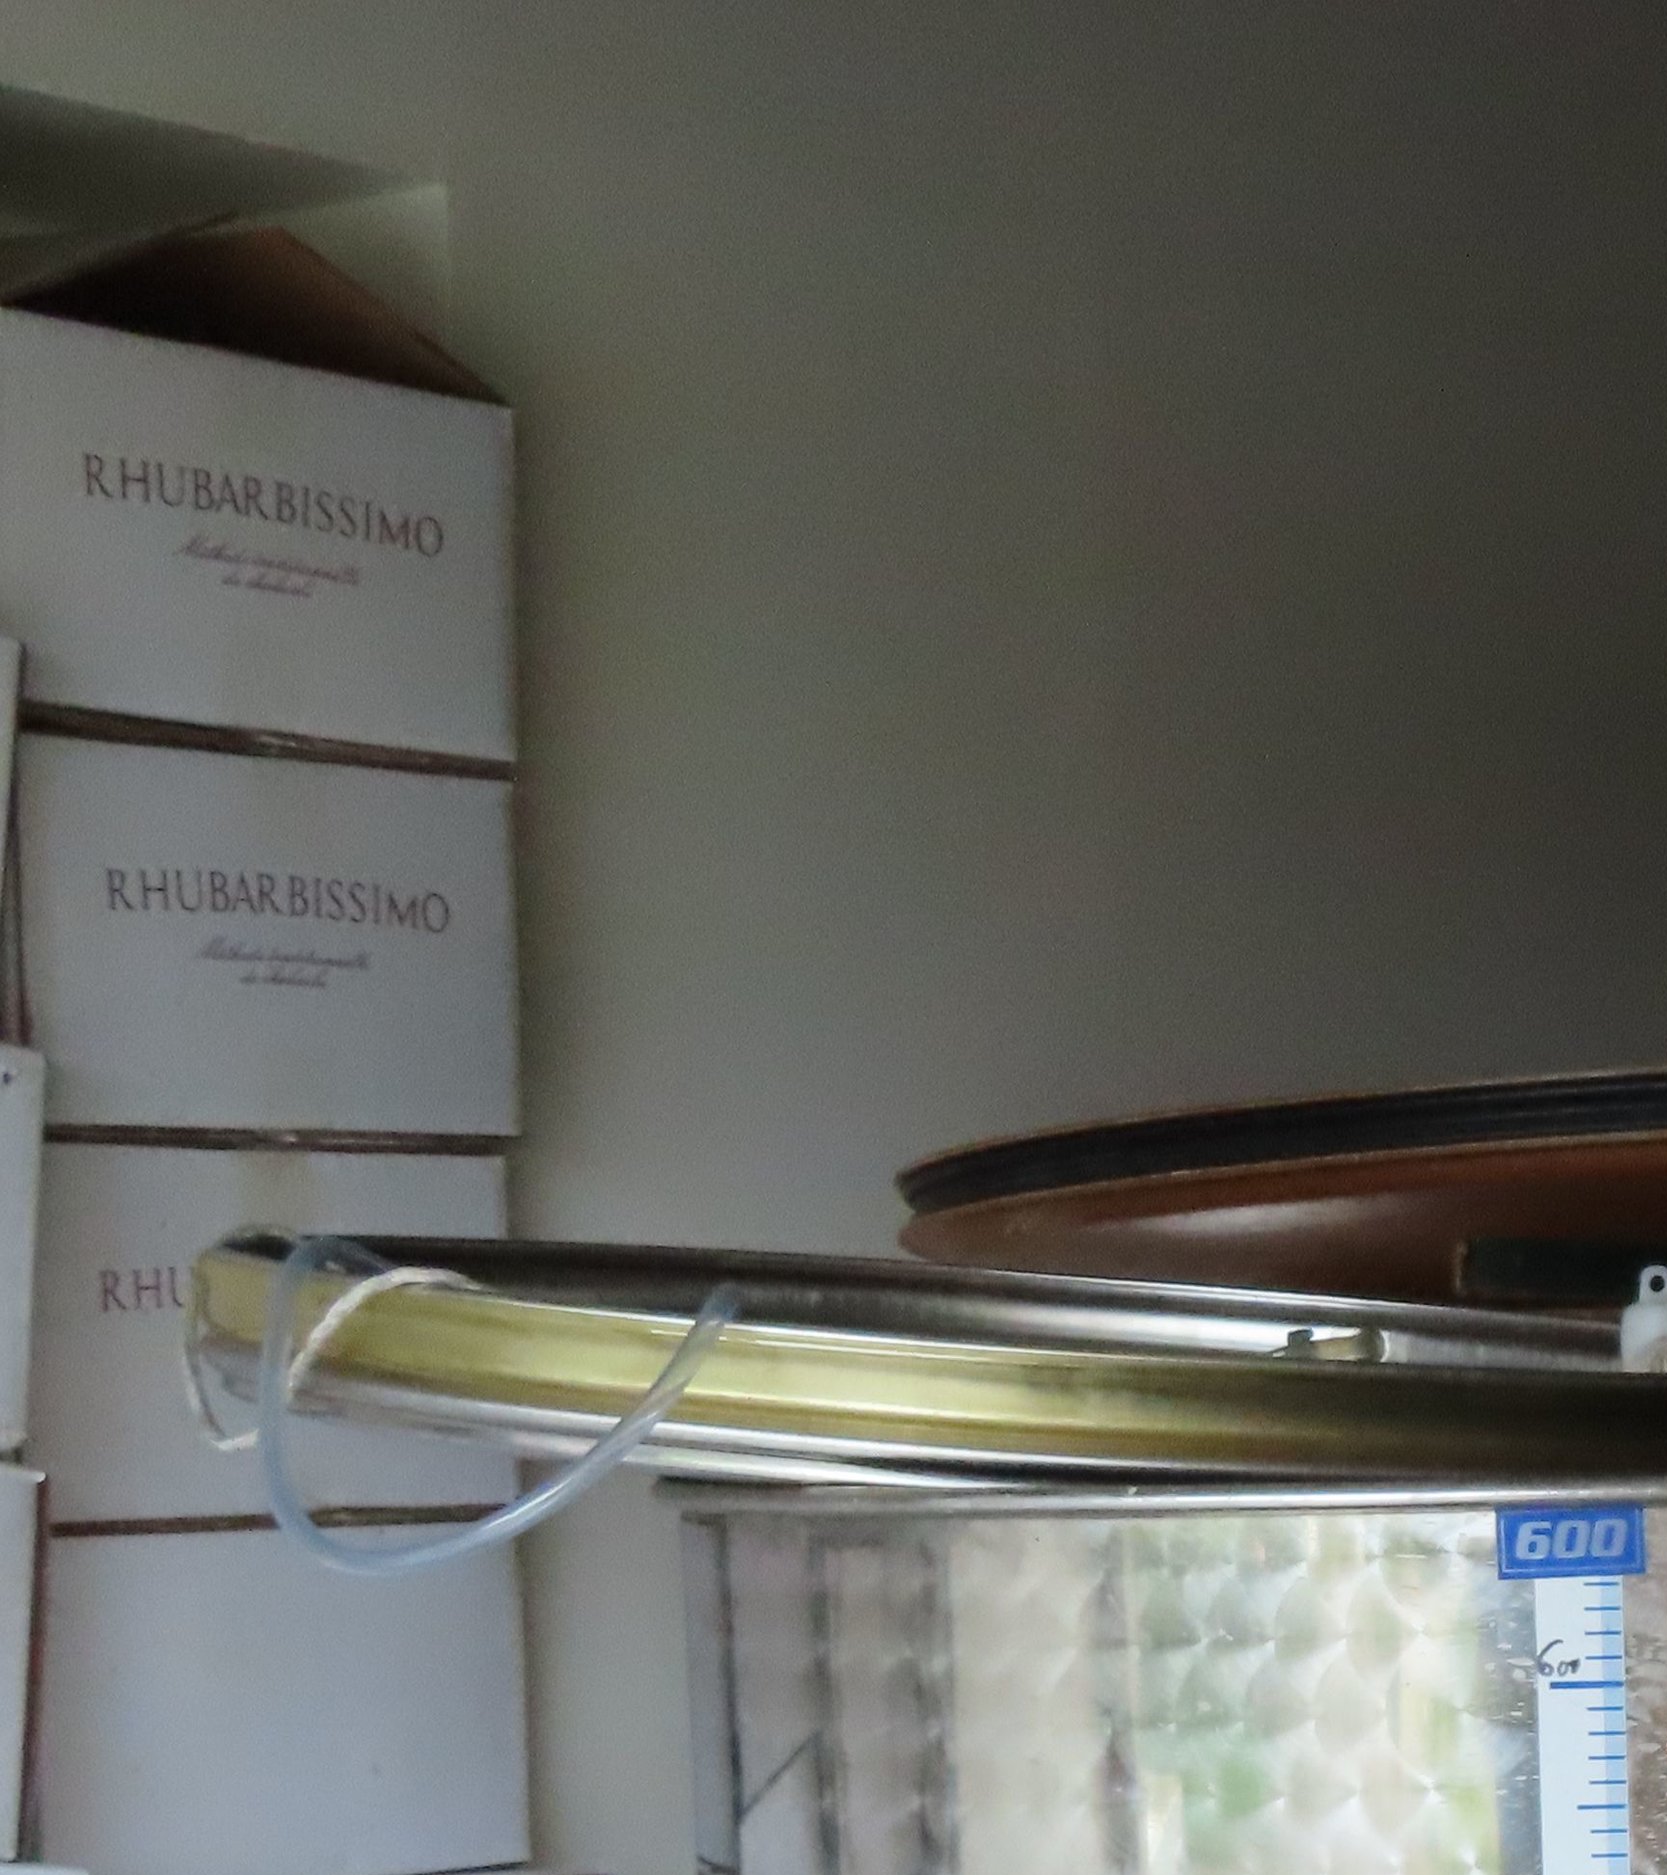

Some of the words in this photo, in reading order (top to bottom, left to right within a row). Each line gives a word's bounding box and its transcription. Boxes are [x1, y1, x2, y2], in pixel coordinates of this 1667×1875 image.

[84, 453, 444, 557] RHUBARBISSIMO
[107, 868, 450, 934] RHUBARBISSIMO
[1515, 1518, 1628, 1561] 600
